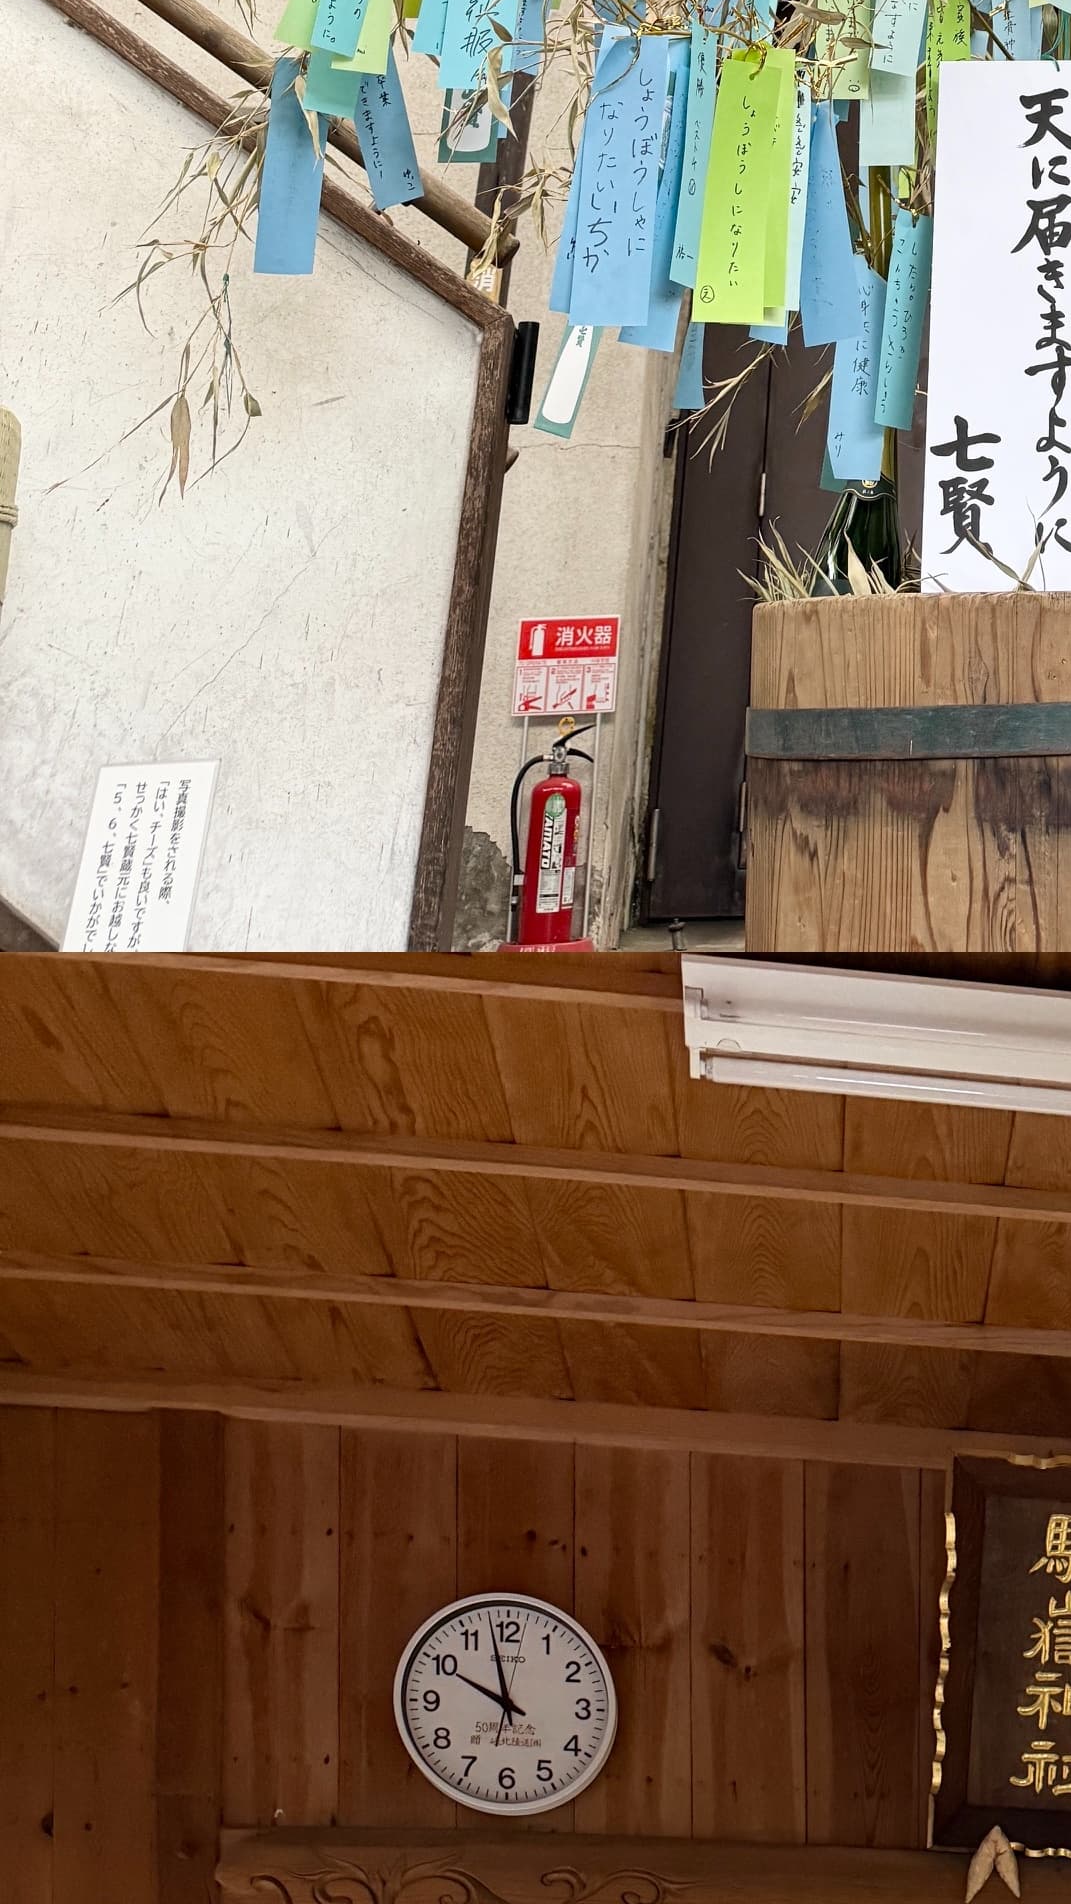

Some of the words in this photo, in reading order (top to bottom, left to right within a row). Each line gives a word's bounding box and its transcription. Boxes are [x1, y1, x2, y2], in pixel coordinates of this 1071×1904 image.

[931, 416, 1001, 557] 七賢
[555, 626, 612, 646] 消火器
[158, 779, 191, 904] 写真撮影をされる際、
[541, 812, 554, 869] AMATO
[461, 1629, 479, 1651] 11
[496, 1621, 521, 1643] 12
[542, 1634, 551, 1654] 1
[432, 1654, 457, 1675] 10
[490, 1655, 526, 1663] SEIKO
[565, 1661, 581, 1683] 2
[423, 1690, 440, 1712] 9
[574, 1698, 591, 1720] 3
[433, 1727, 451, 1749] 8
[563, 1735, 582, 1756] 4
[461, 1756, 477, 1777] 7
[536, 1760, 553, 1782] 5
[498, 1767, 516, 1789] 6
